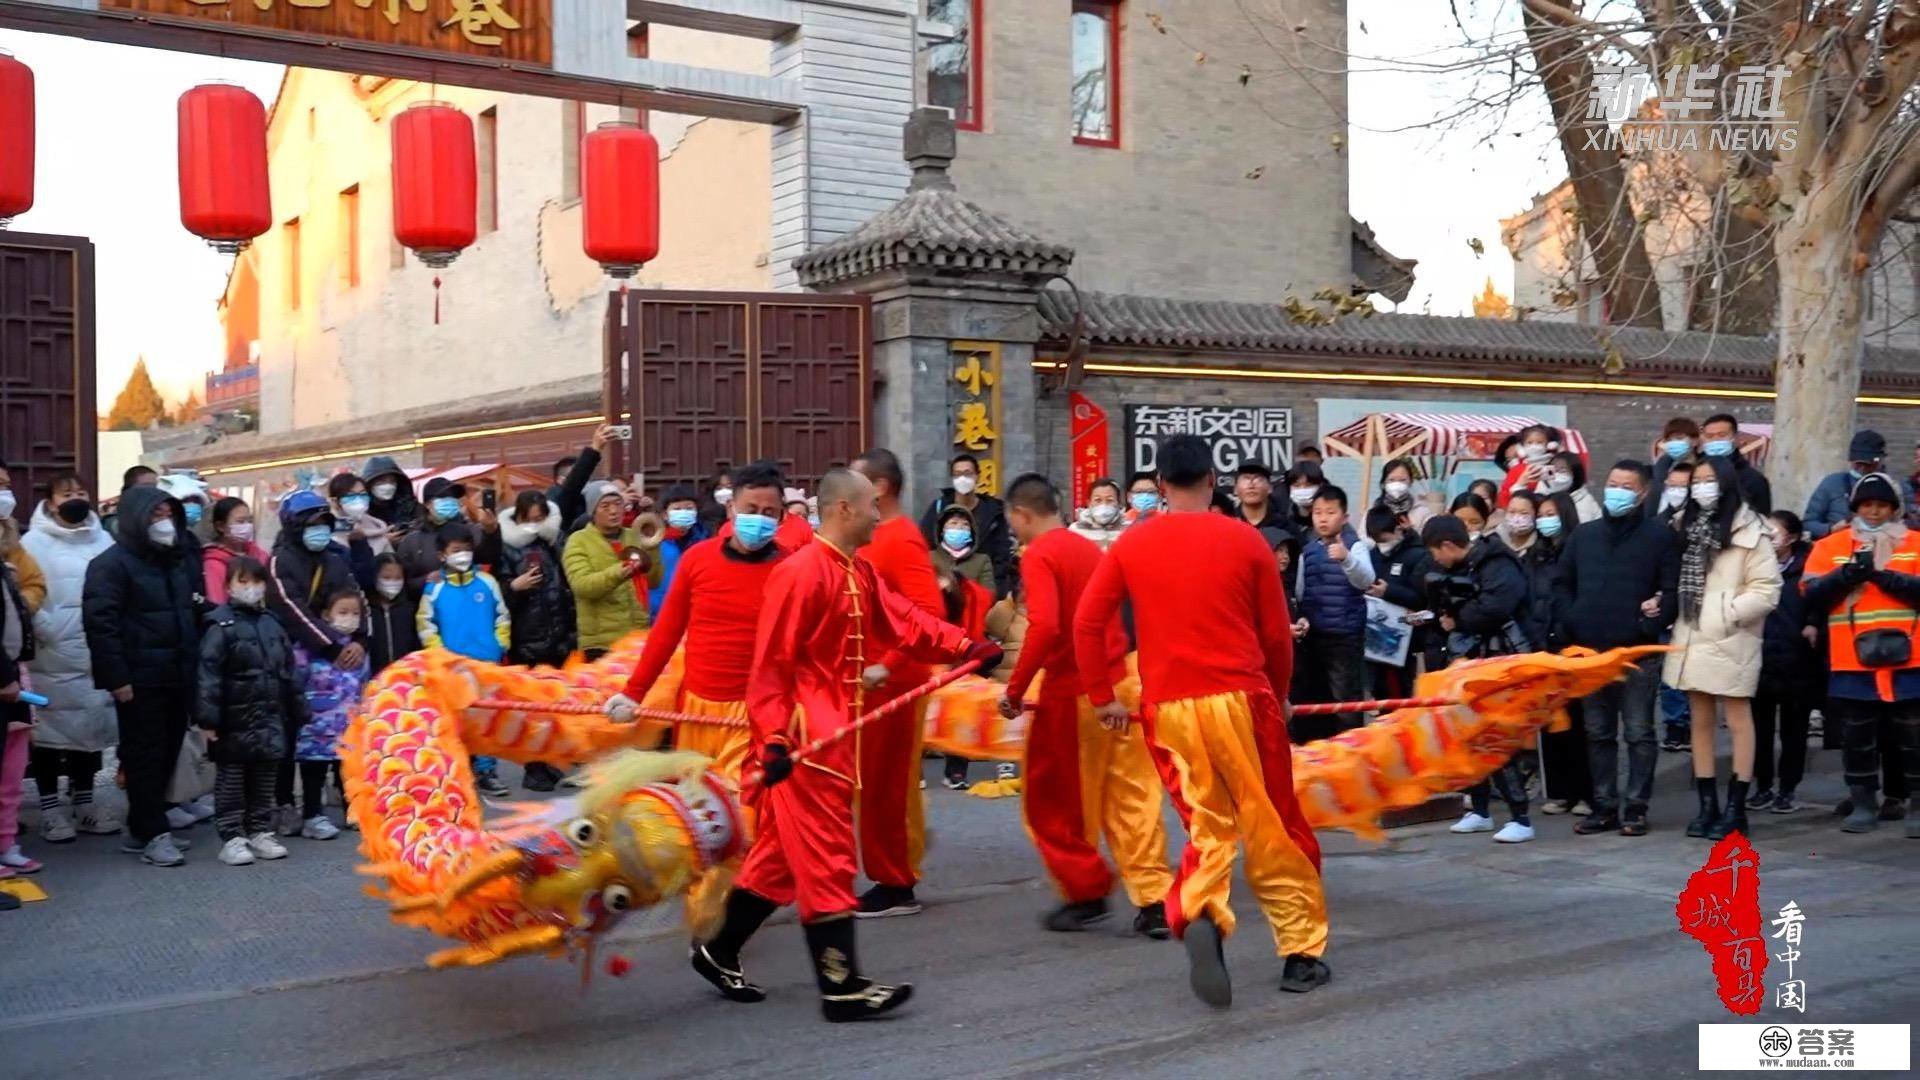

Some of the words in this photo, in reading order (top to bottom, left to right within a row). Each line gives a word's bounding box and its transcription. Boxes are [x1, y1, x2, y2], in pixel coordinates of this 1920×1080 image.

[1134, 405, 1293, 437] 东新文创园
[1134, 437, 1293, 473] DGXIN
